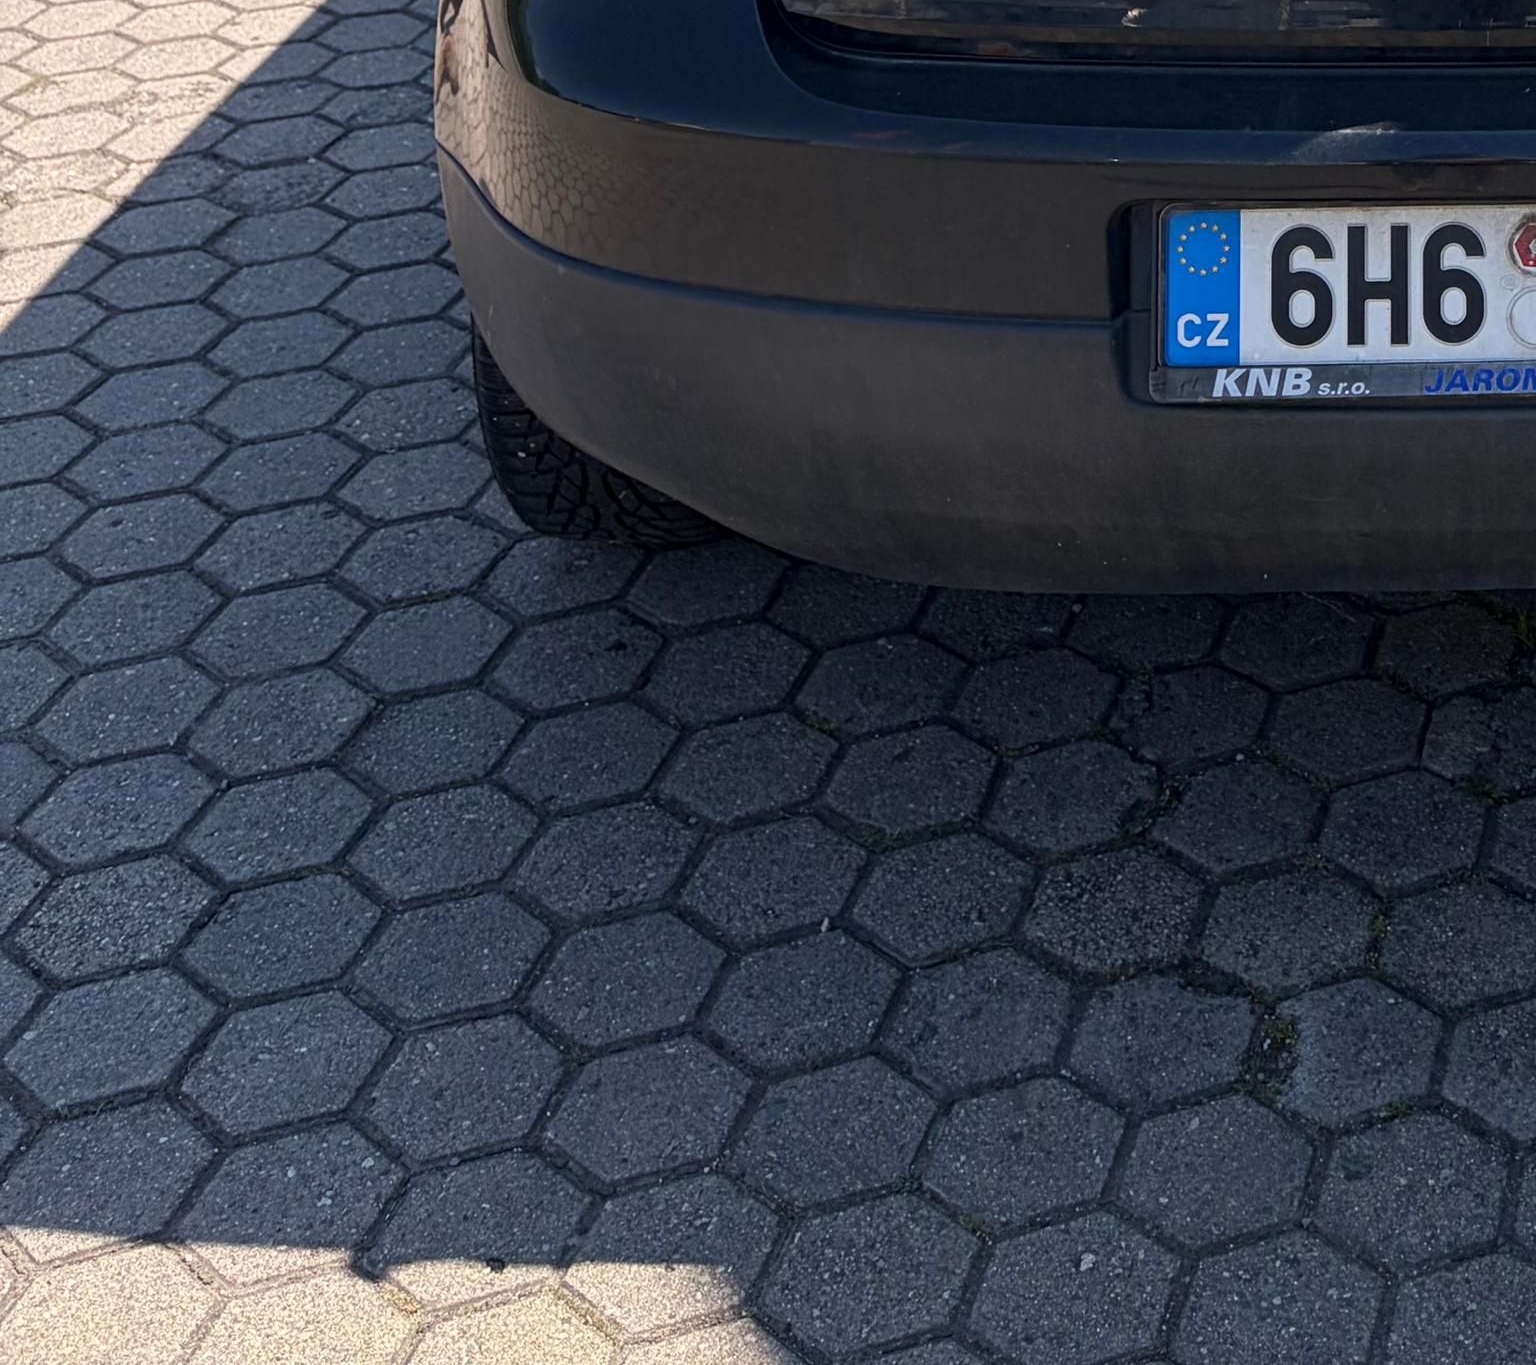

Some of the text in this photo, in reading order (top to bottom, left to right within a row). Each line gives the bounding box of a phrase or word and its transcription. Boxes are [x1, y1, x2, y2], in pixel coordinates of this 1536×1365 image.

[1269, 221, 1488, 349] 6H6
[1175, 310, 1232, 350] CZ
[1211, 367, 1314, 399] KNB
[1317, 380, 1371, 396] s.r.o.
